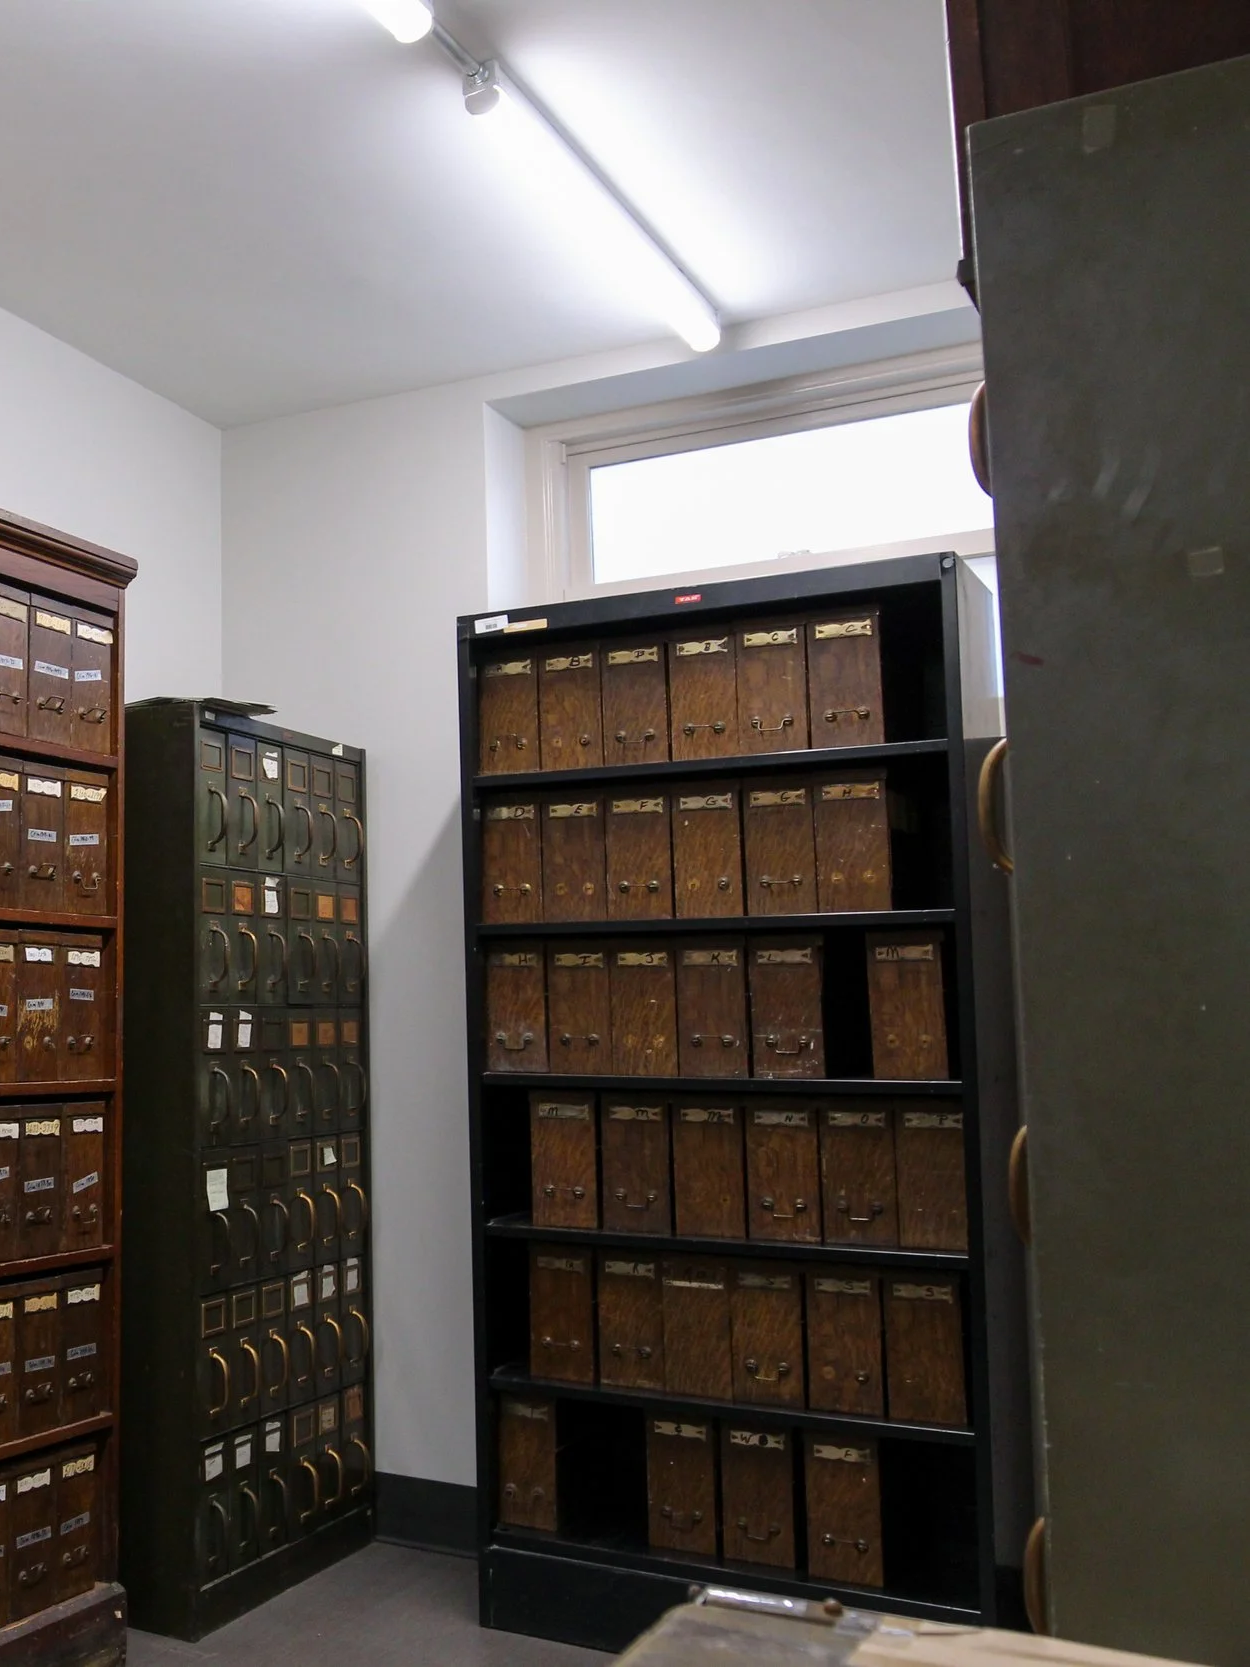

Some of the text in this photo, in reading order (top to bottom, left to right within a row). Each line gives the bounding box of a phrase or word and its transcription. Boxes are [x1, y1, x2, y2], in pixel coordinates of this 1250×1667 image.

[771, 632, 779, 641] C
[569, 656, 580, 667] B
[573, 804, 583, 814] E
[639, 801, 648, 810] F
[513, 807, 525, 817] D
[518, 955, 528, 965] H
[578, 955, 591, 965] I
[645, 953, 654, 964] J
[710, 952, 721, 963] K
[767, 953, 777, 962] L
[784, 1113, 793, 1122] N
[925, 1287, 934, 1297] S
[739, 1433, 752, 1445] W
